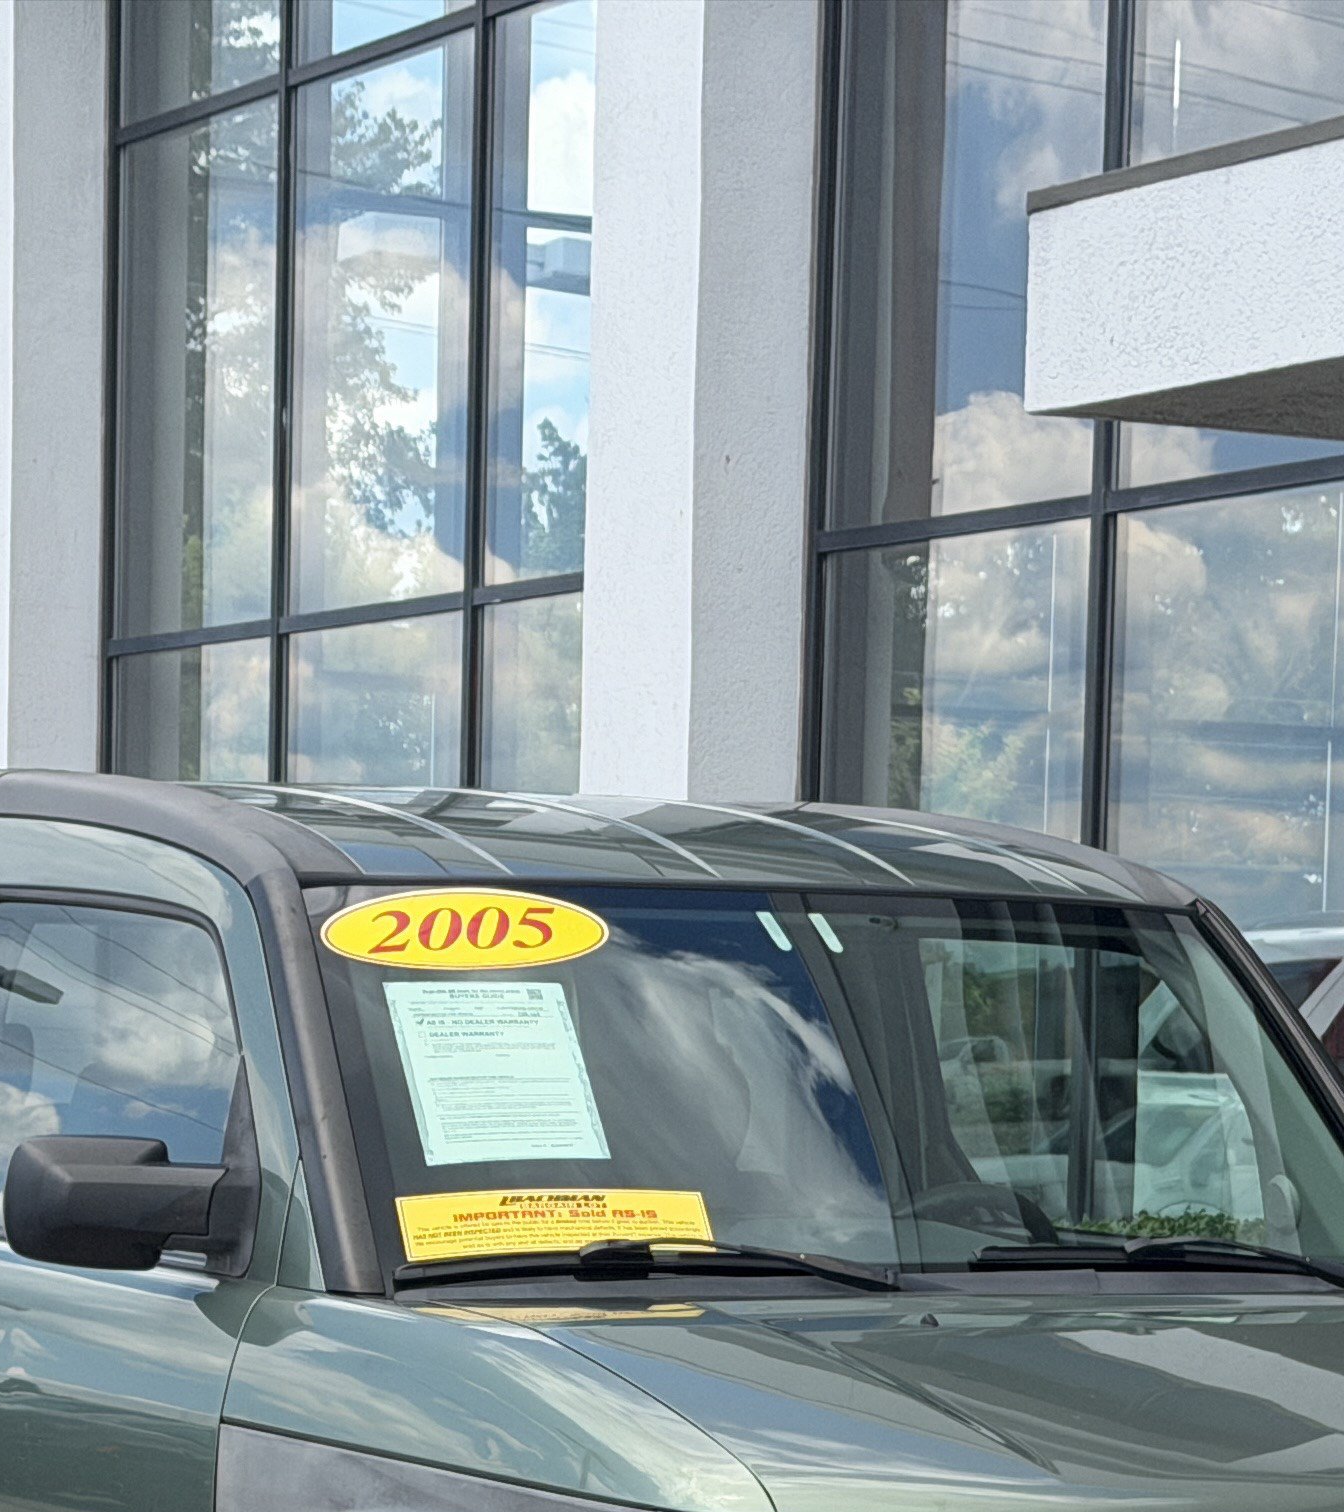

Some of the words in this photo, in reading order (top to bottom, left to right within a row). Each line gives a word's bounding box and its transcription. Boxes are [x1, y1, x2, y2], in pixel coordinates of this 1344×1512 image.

[368, 906, 555, 954] 2005
[453, 1209, 562, 1223] IMPORTANT:
[568, 1209, 606, 1218] Sold
